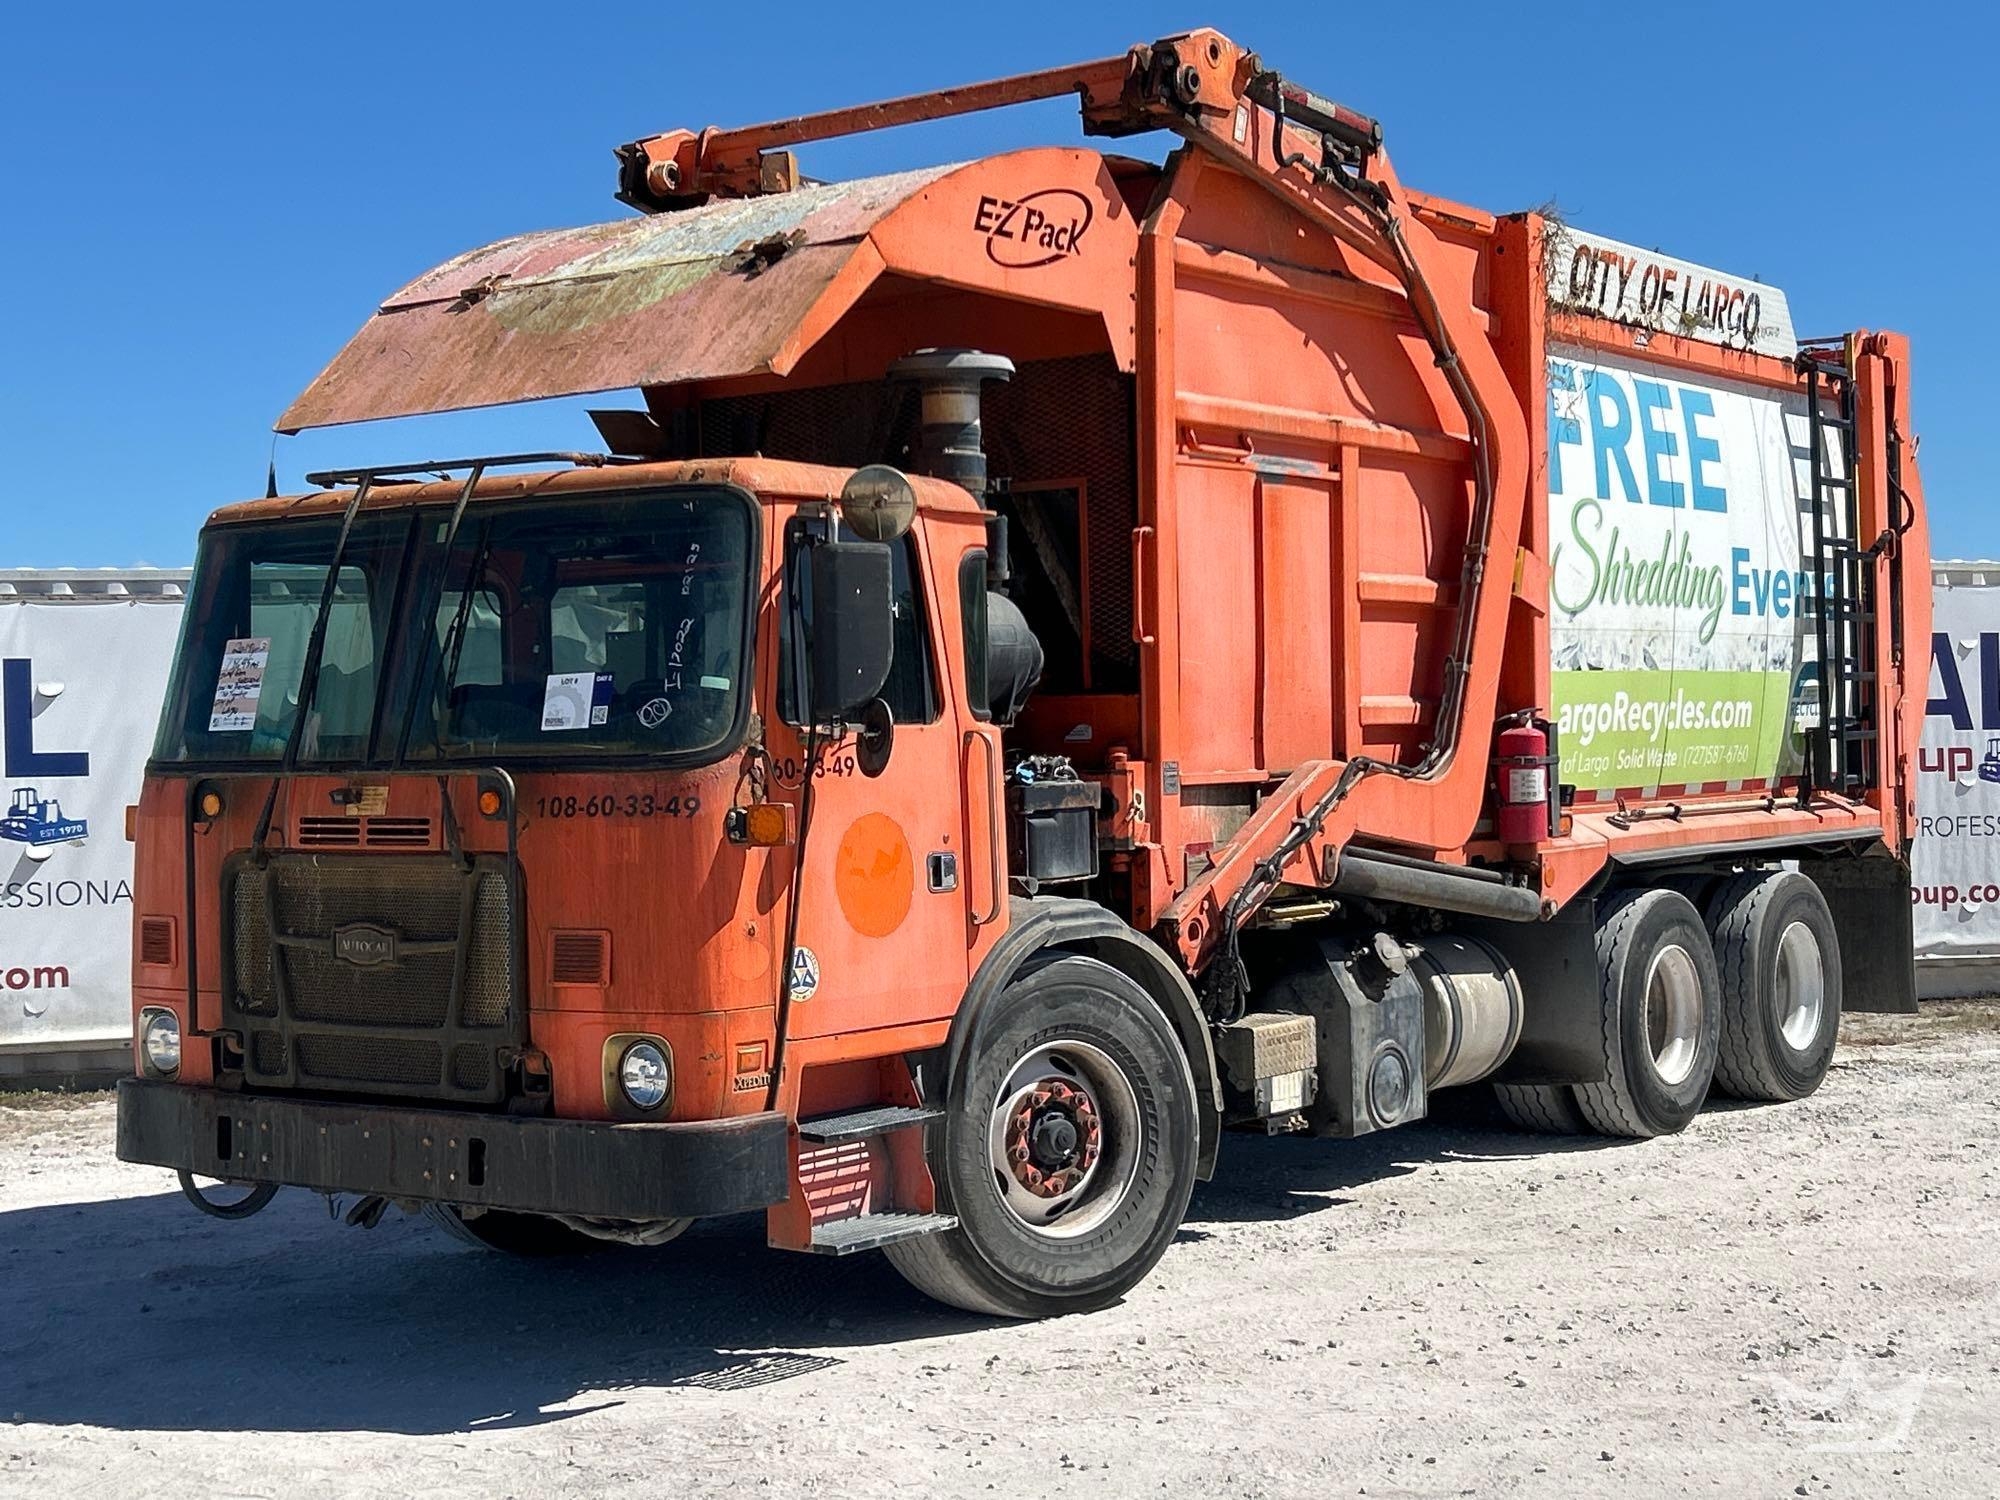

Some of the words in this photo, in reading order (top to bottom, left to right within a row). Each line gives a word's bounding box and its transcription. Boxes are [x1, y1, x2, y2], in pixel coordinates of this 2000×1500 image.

[1020, 206, 1081, 256] Pack
[1640, 263, 1677, 316] OF
[1679, 275, 1761, 342] LARGO
[1547, 362, 1728, 514] FREE
[1551, 498, 1727, 645] Shredding
[3, 658, 89, 778] L
[1551, 687, 1753, 747] argoRecycles.com
[773, 756, 854, 780] 60-3-49
[1564, 751, 1578, 774] of
[1578, 752, 1610, 777] Largo
[1616, 747, 1646, 770] Solid
[1646, 746, 1678, 767] Waste
[1683, 744, 1749, 768] (727)587-6760
[536, 795, 701, 818] 108-60-33-49
[59, 825, 84, 835] 1970
[1916, 815, 2000, 837] ROFES
[0, 880, 133, 908] SSIONA
[0, 965, 69, 989] om
